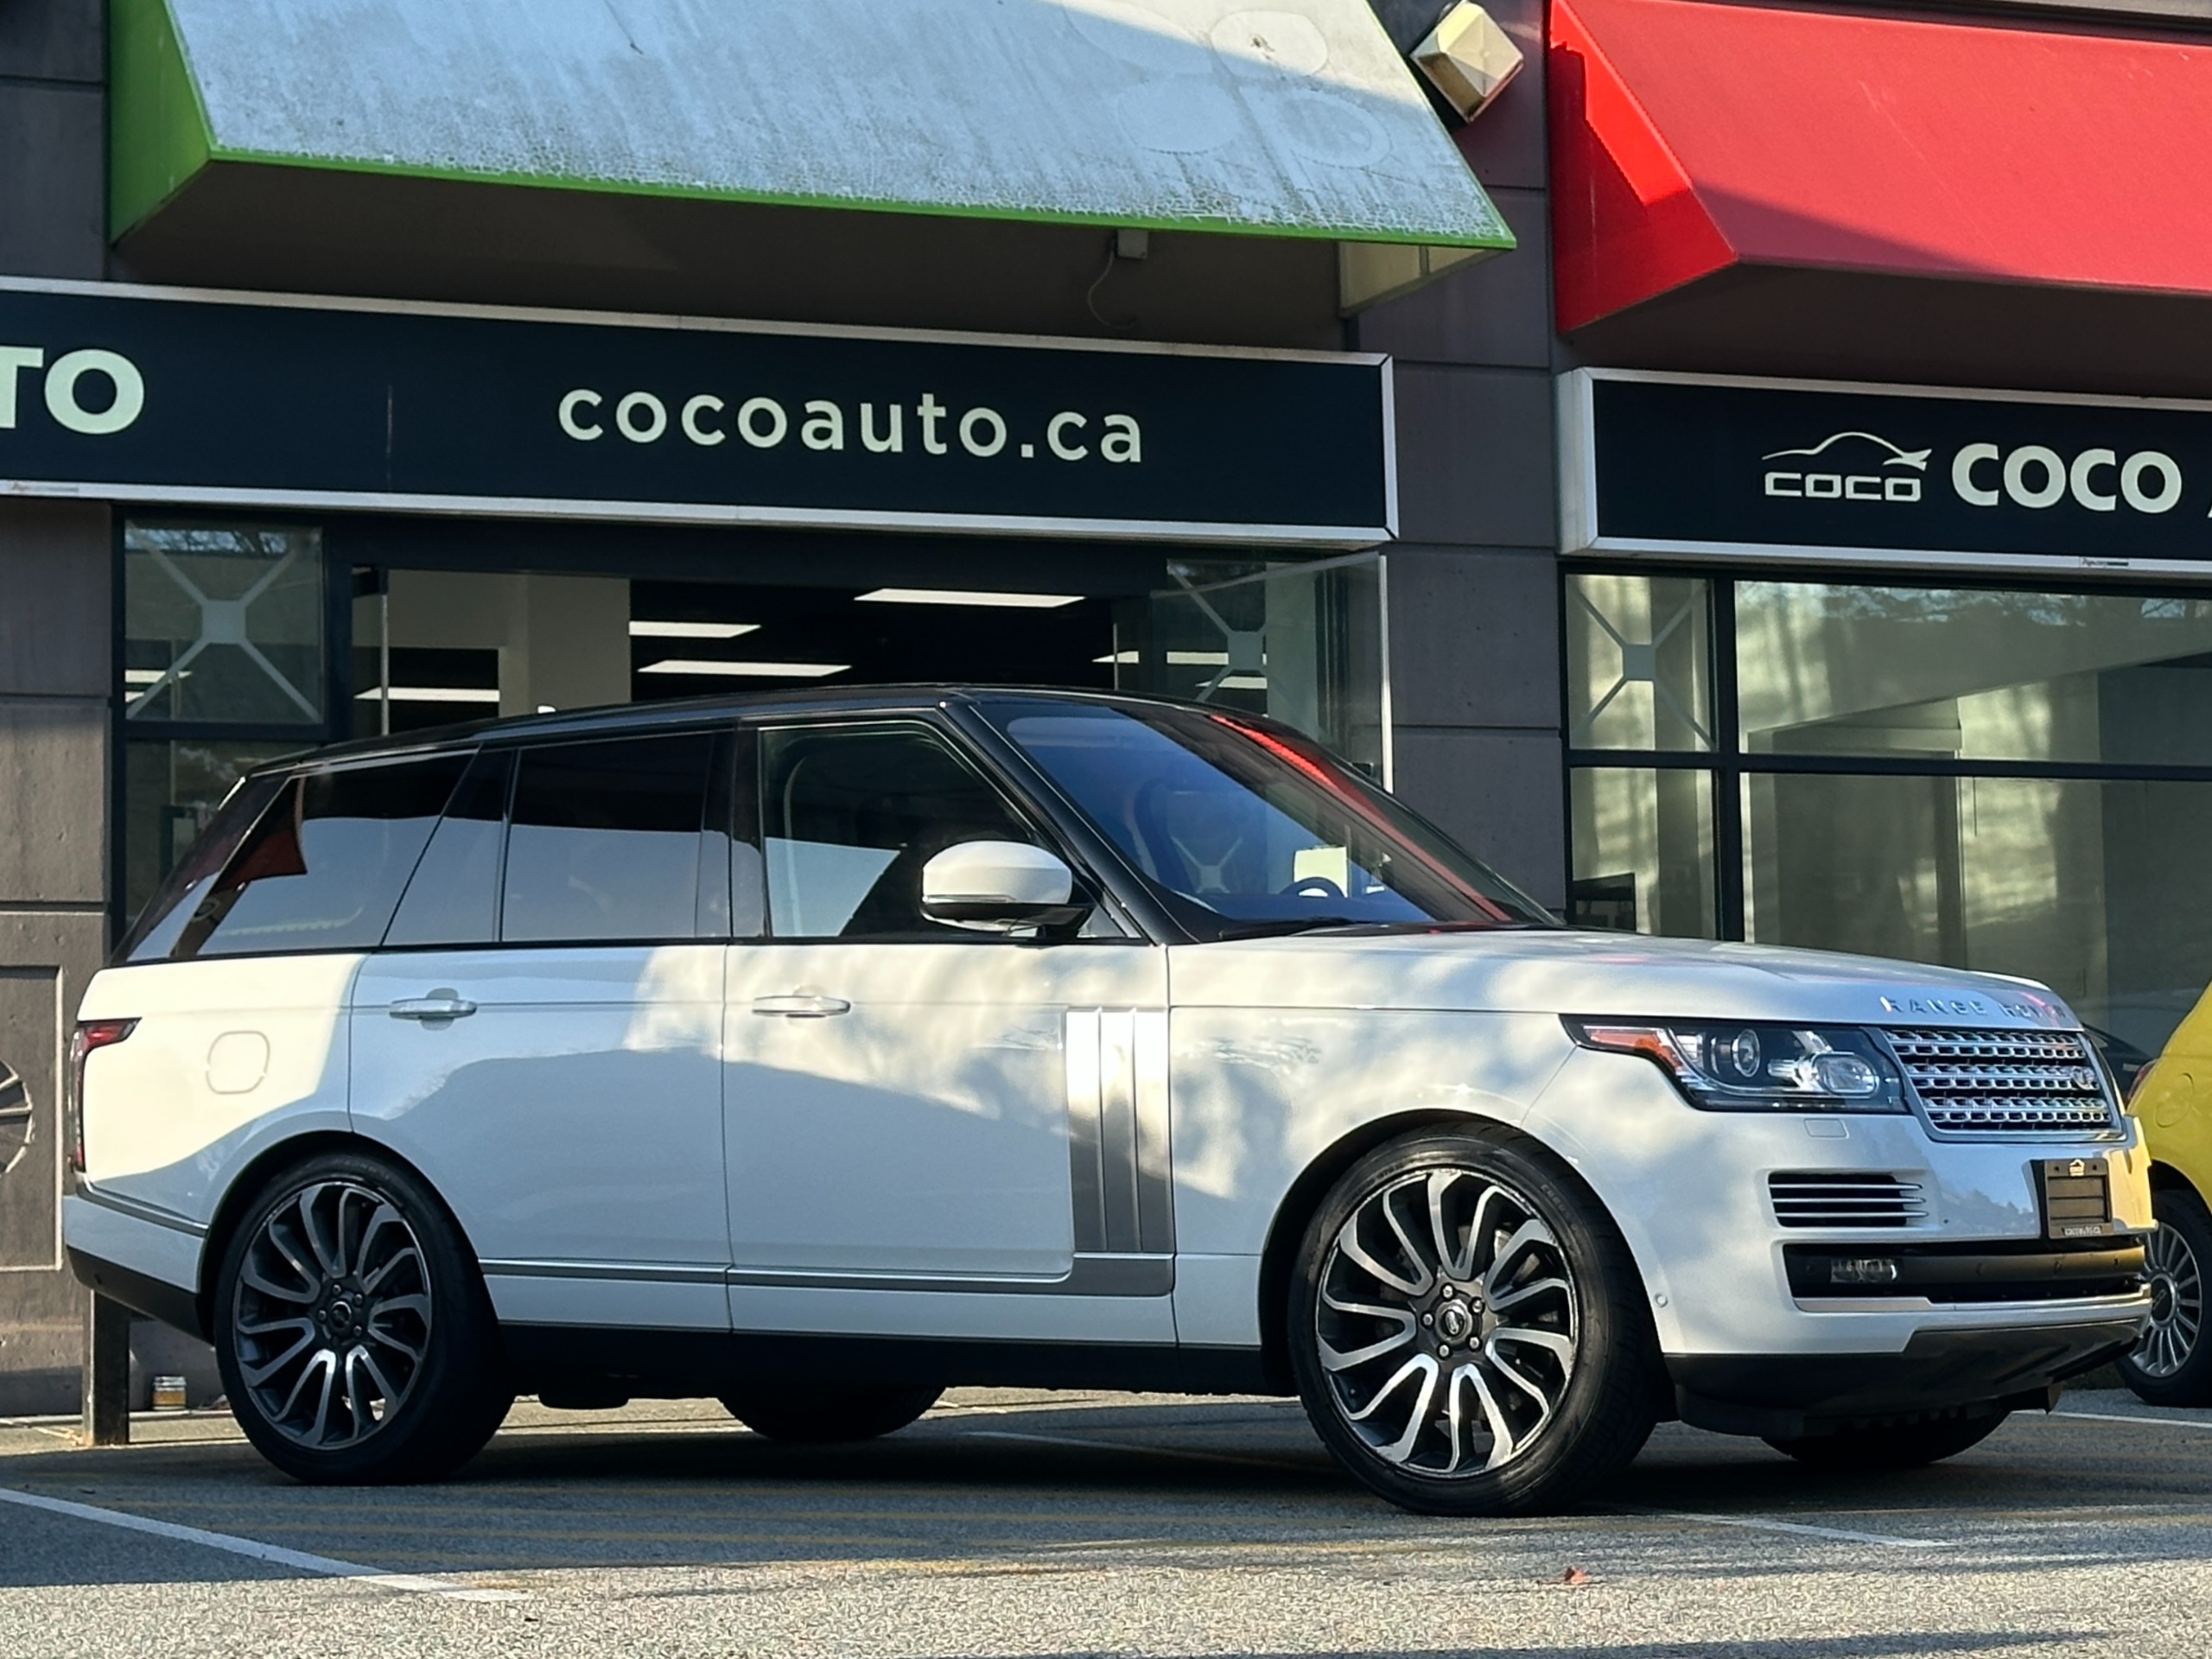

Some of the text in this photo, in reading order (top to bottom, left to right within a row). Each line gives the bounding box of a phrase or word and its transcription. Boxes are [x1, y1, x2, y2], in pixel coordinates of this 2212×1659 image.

[0, 346, 145, 435] TO
[558, 388, 1142, 464] cocoauto.ca
[1764, 471, 1923, 503] COCO
[1951, 442, 2183, 514] COCO
[1879, 995, 1987, 1015] RANGE
